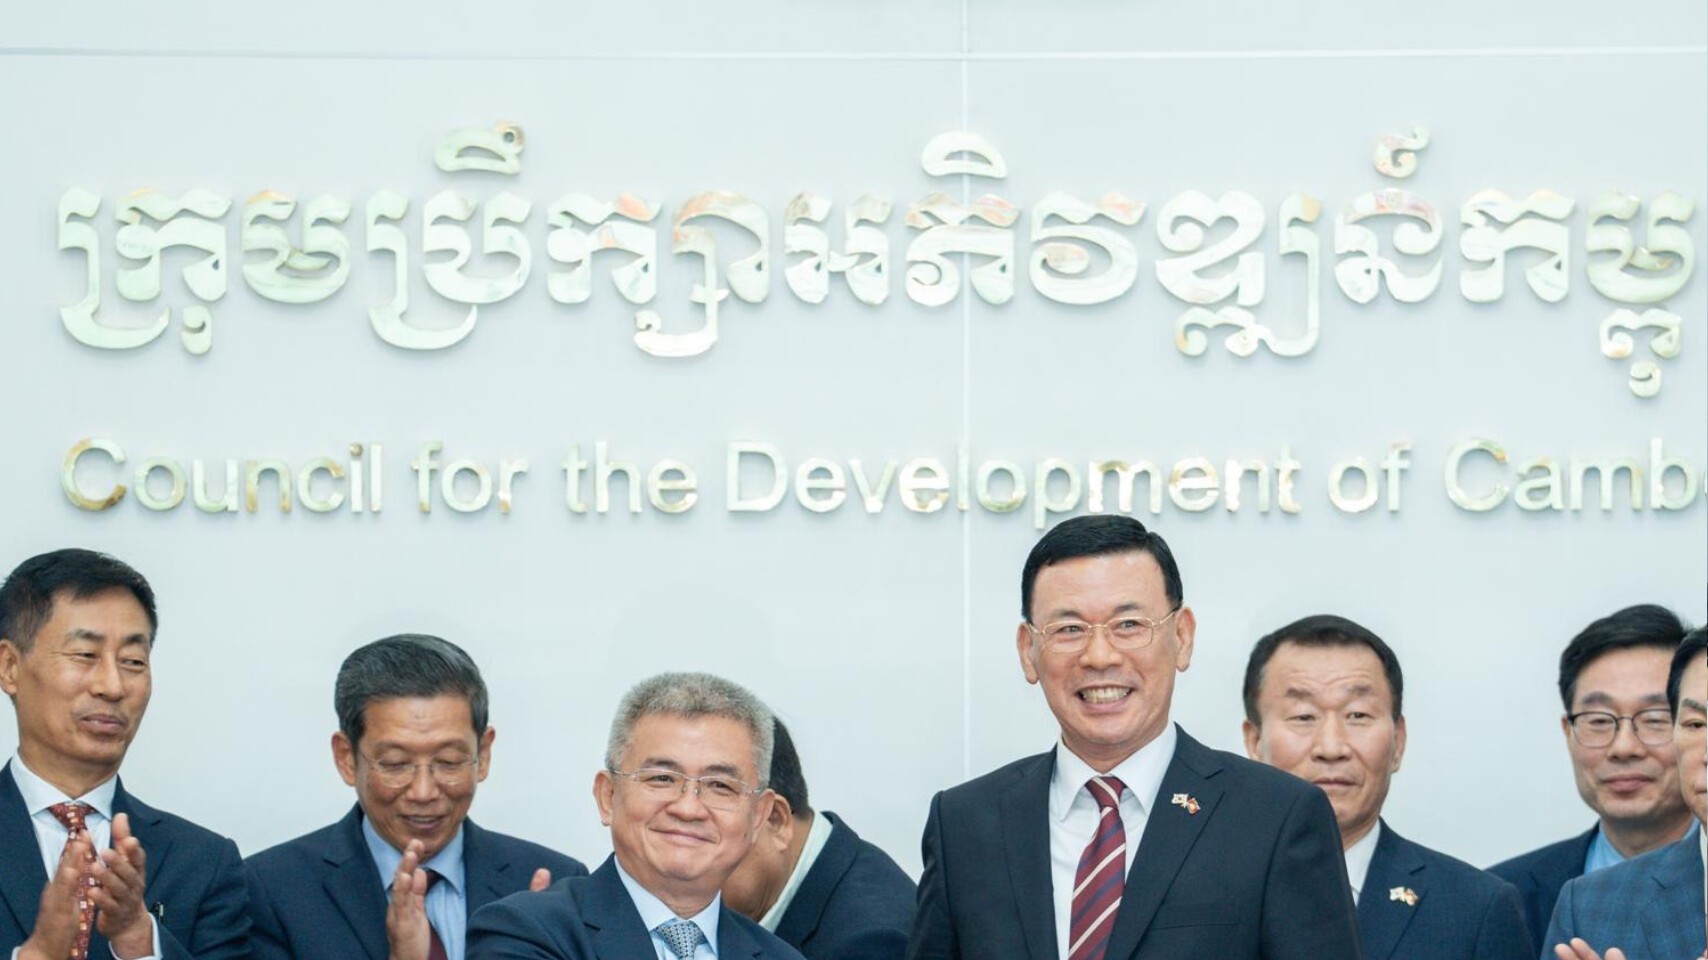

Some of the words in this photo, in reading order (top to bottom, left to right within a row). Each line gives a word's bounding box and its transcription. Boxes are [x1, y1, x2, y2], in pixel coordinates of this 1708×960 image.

[60, 436, 383, 514] Council
[411, 440, 529, 514] for
[560, 440, 699, 514] the
[725, 438, 1301, 529] Development
[1328, 440, 1412, 513] of
[1444, 436, 1707, 513] Camb
